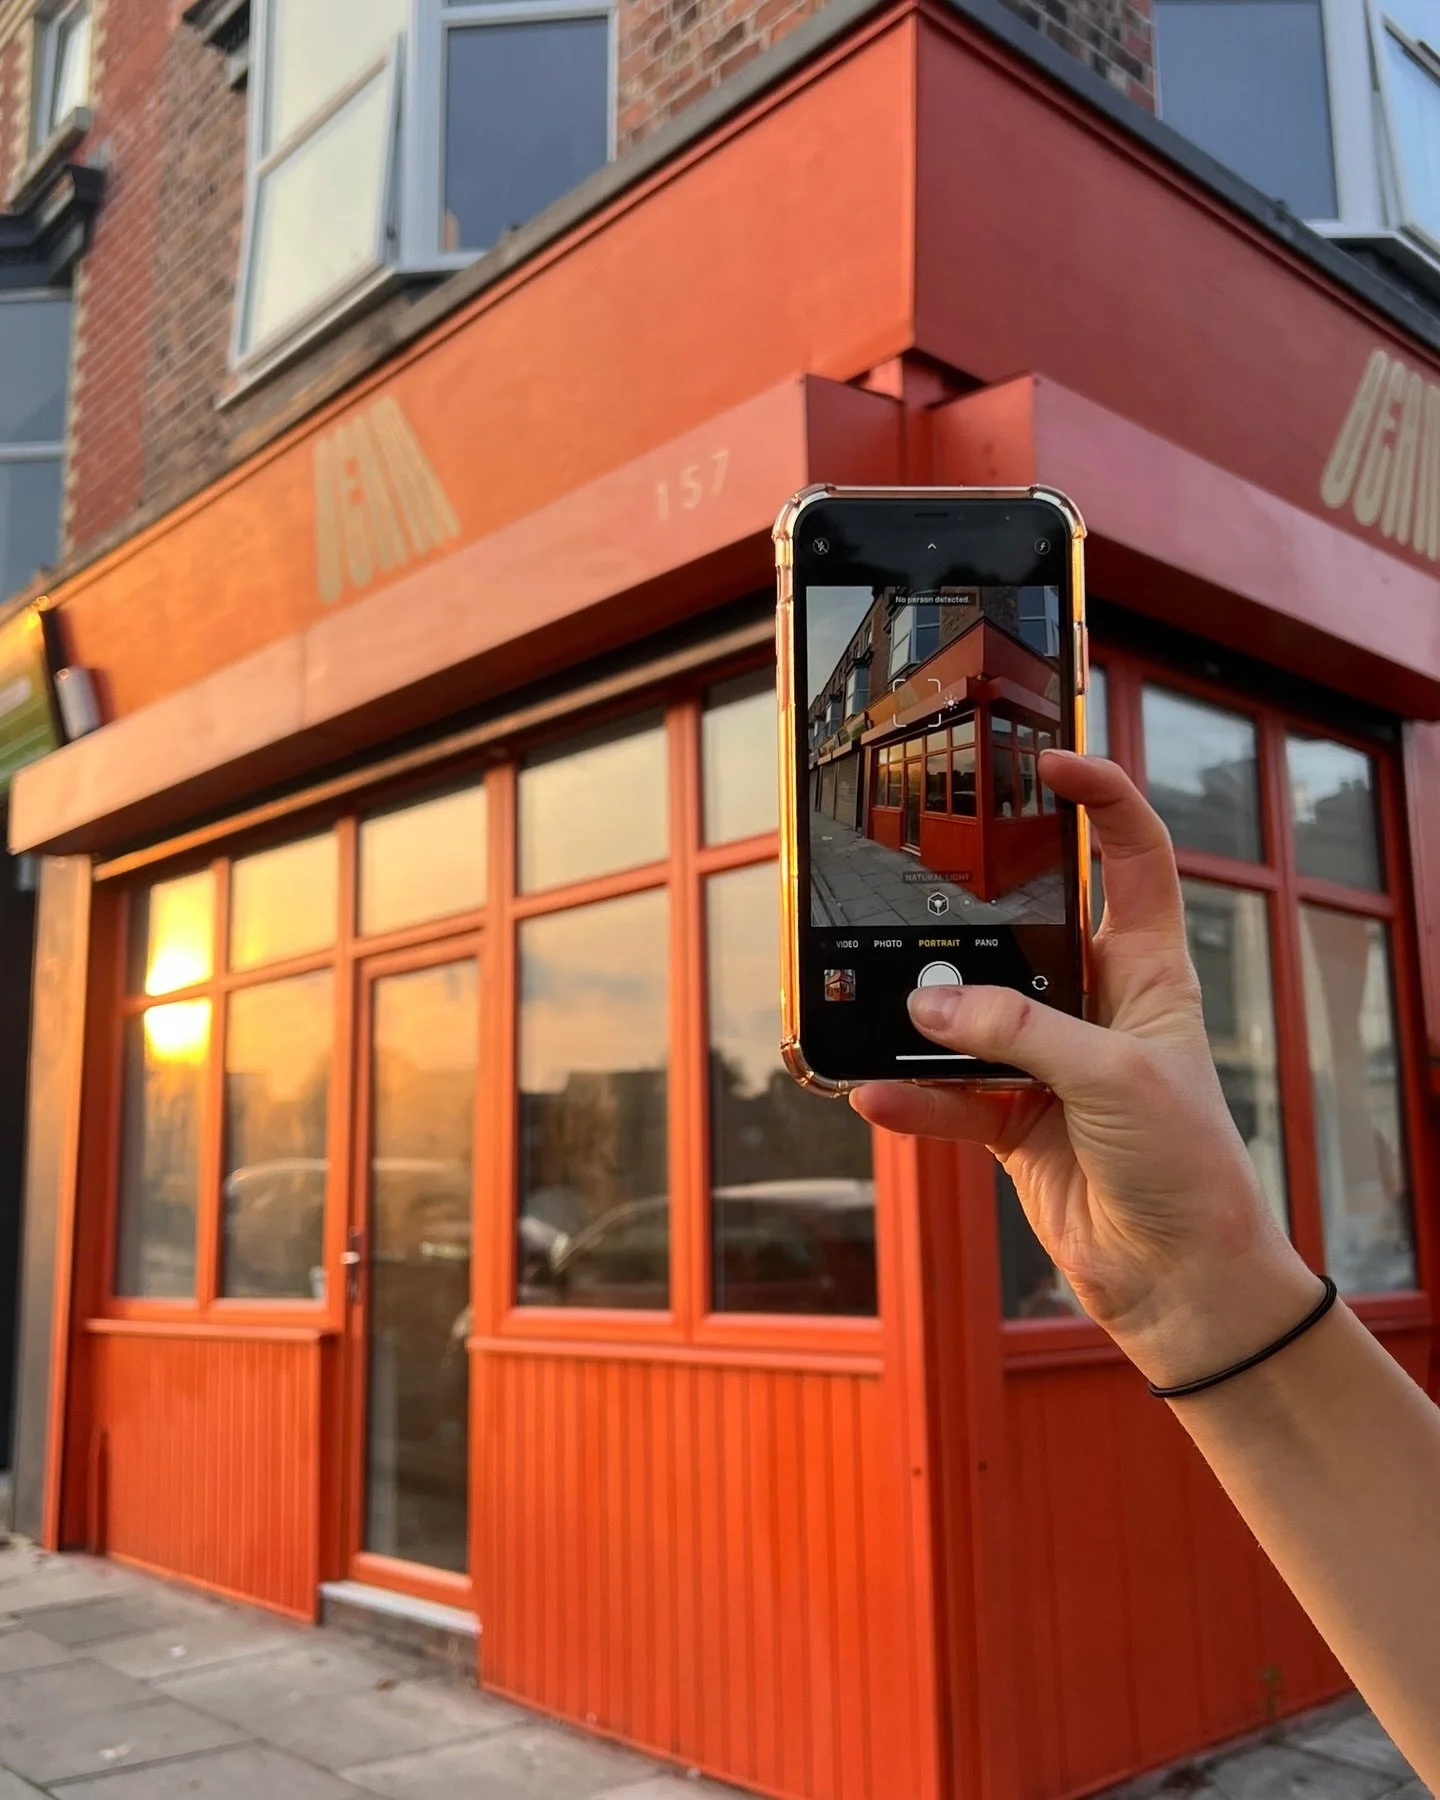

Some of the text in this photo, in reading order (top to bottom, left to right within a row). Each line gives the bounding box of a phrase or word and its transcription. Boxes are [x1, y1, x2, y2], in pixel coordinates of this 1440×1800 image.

[656, 449, 730, 520] 157
[907, 596, 934, 604] person
[904, 873, 970, 881] NATURAL LIGHT
[836, 938, 999, 948] VIDEO PHOTO PORTRAIT PANO
